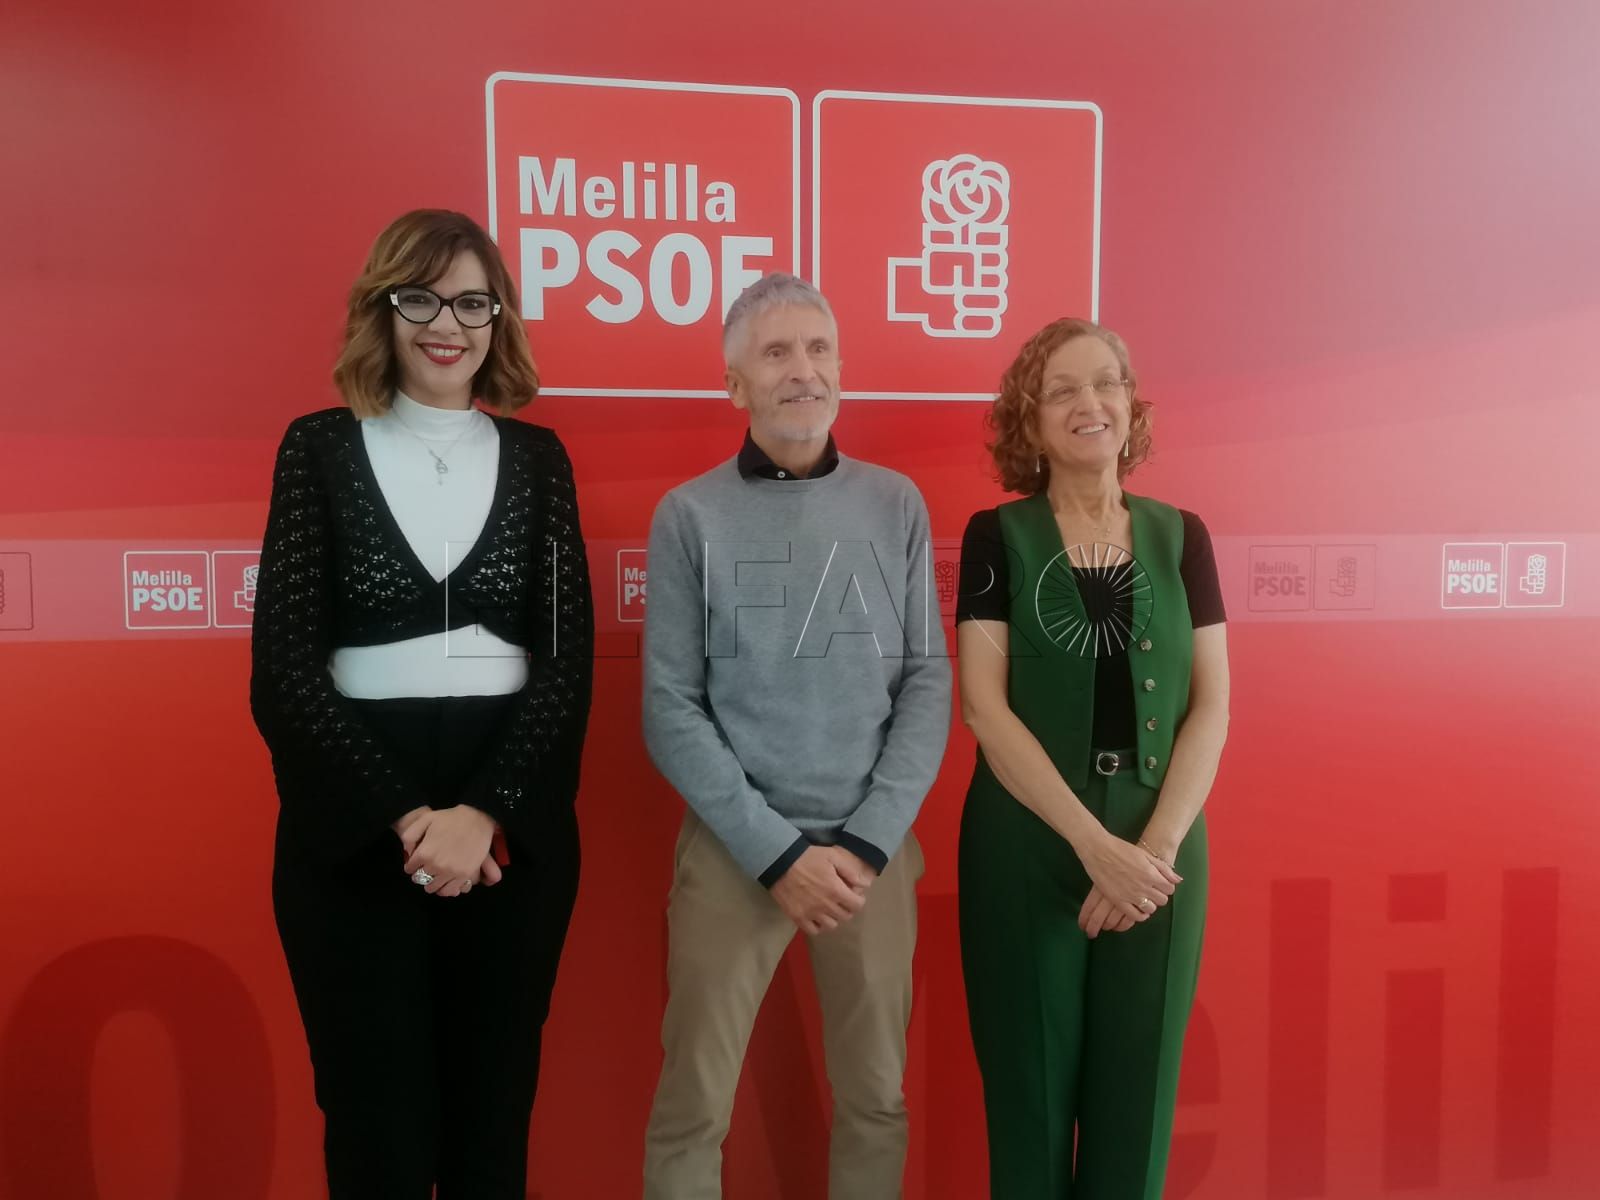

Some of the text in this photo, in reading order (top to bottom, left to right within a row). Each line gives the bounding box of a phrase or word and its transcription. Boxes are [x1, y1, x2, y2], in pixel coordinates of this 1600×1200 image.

[518, 155, 736, 223] Melilla
[519, 228, 774, 326] PSOE
[1254, 562, 1299, 574] Melilla
[1448, 559, 1491, 572] Melilla
[133, 570, 192, 586] Melilla
[1254, 575, 1306, 597] PSOE
[1447, 573, 1498, 594] PSOE
[133, 588, 203, 611] PSOE
